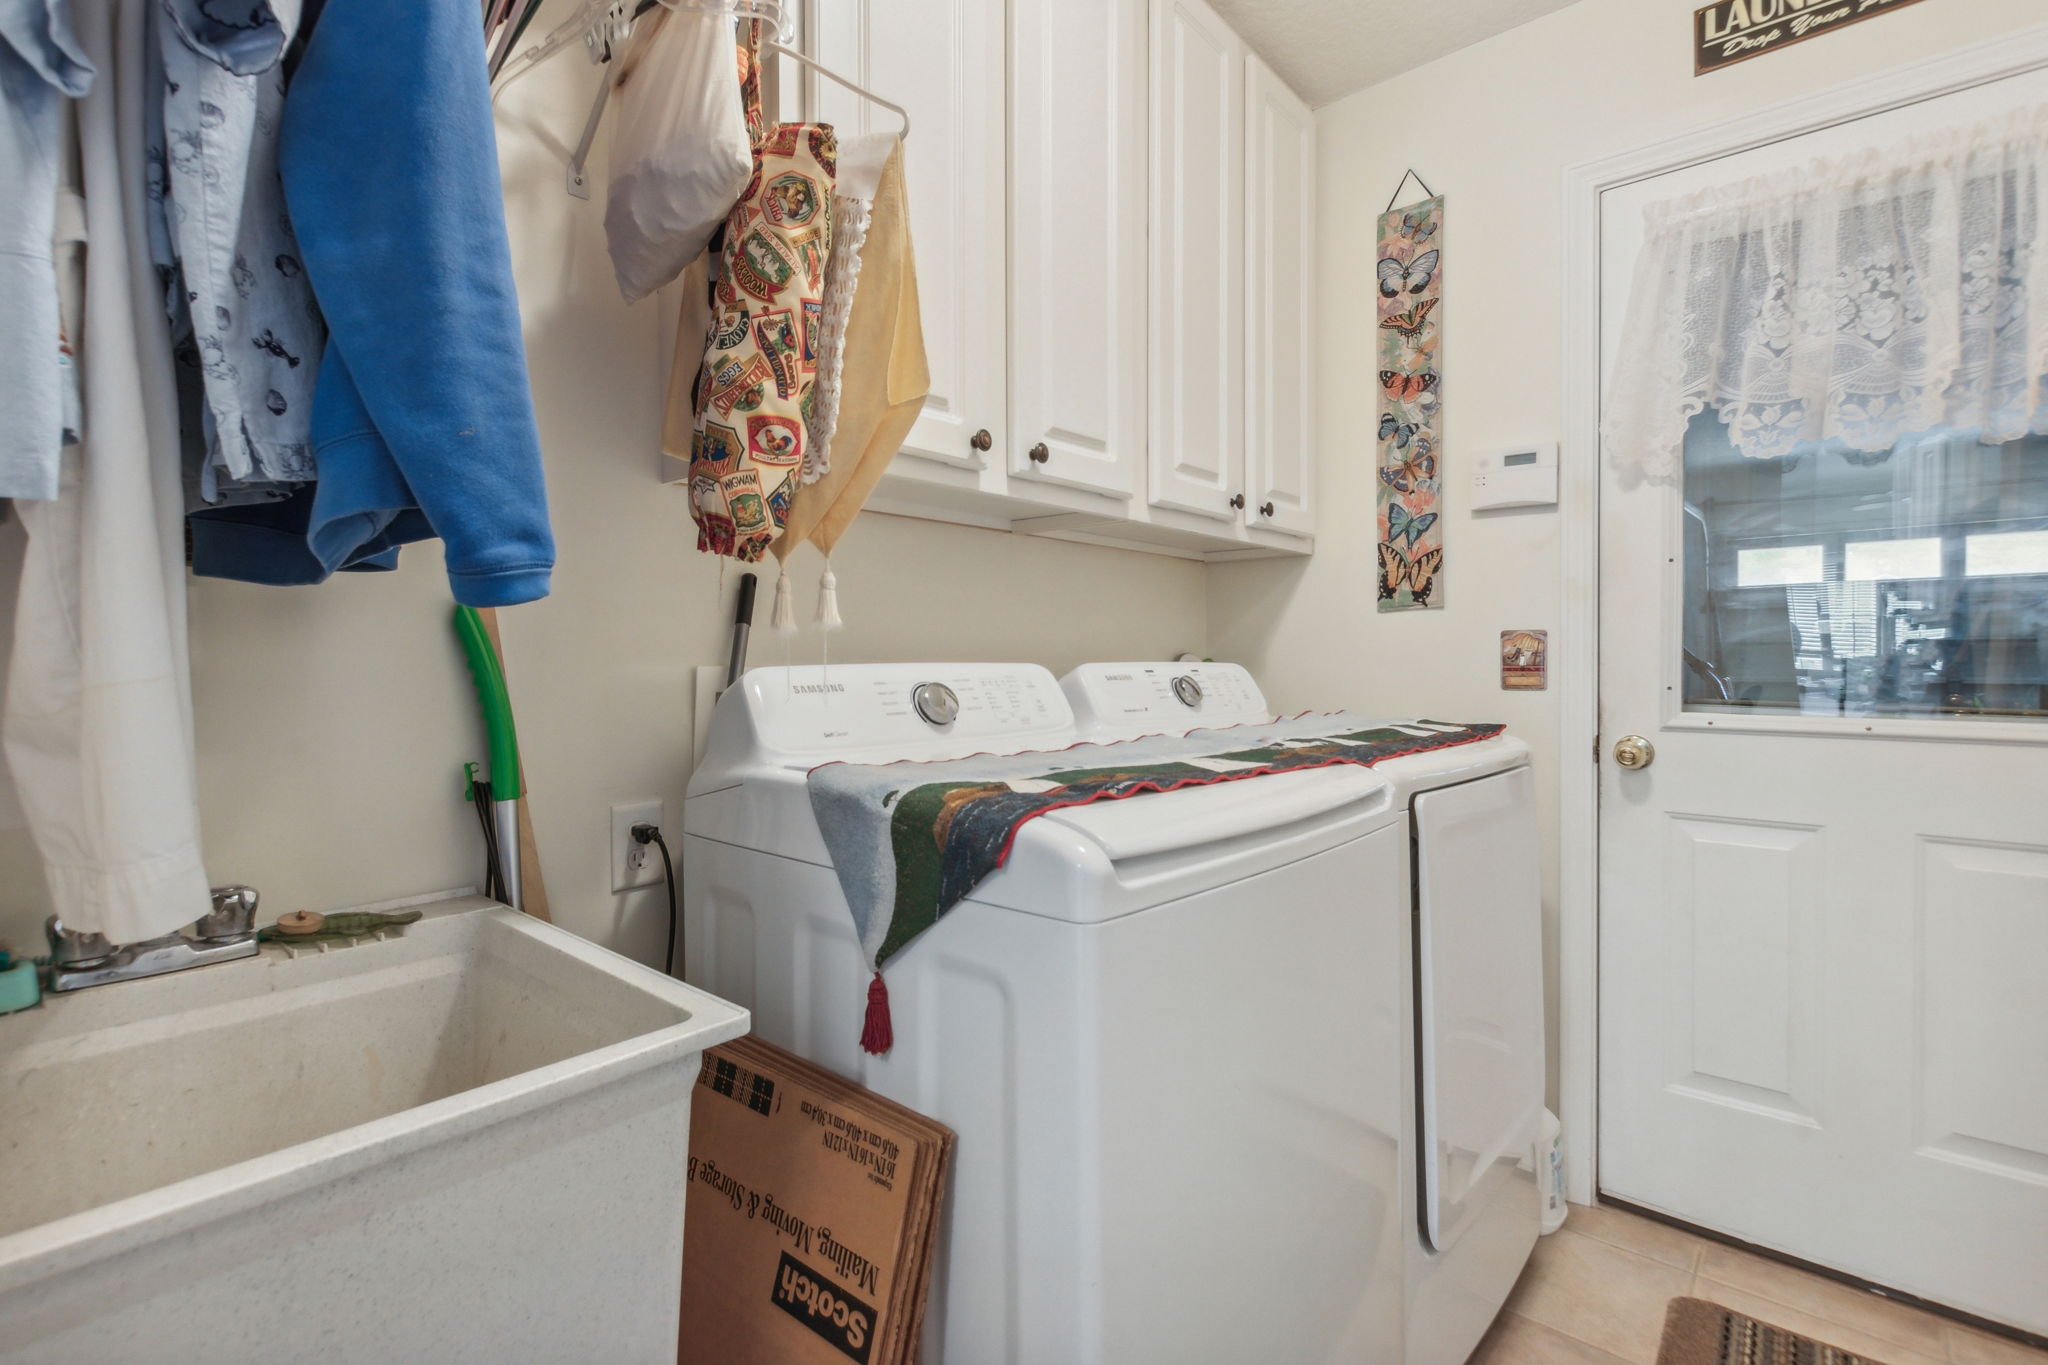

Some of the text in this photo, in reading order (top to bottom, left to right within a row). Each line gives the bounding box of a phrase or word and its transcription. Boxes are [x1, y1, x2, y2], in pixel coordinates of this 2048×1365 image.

[1722, 7, 1851, 57] Drop Your
[717, 361, 744, 387] EGGS
[722, 473, 758, 492] WIGWAM
[793, 683, 845, 694] SAMSUNG
[801, 1100, 812, 1115] cm
[828, 1113, 833, 1125] x
[834, 1115, 845, 1131] cm
[822, 1130, 834, 1149] IN
[863, 1130, 869, 1142] x
[869, 1132, 881, 1148] cm
[848, 1141, 860, 1162] IN
[859, 1148, 868, 1166] 16
[874, 1155, 886, 1176] IN
[887, 1161, 896, 1180] 16
[700, 1159, 746, 1211] Storage
[748, 1190, 760, 1219] &
[761, 1193, 814, 1256] Moving
[817, 1226, 881, 1297] Mailing,
[780, 1262, 868, 1350] Scotch
